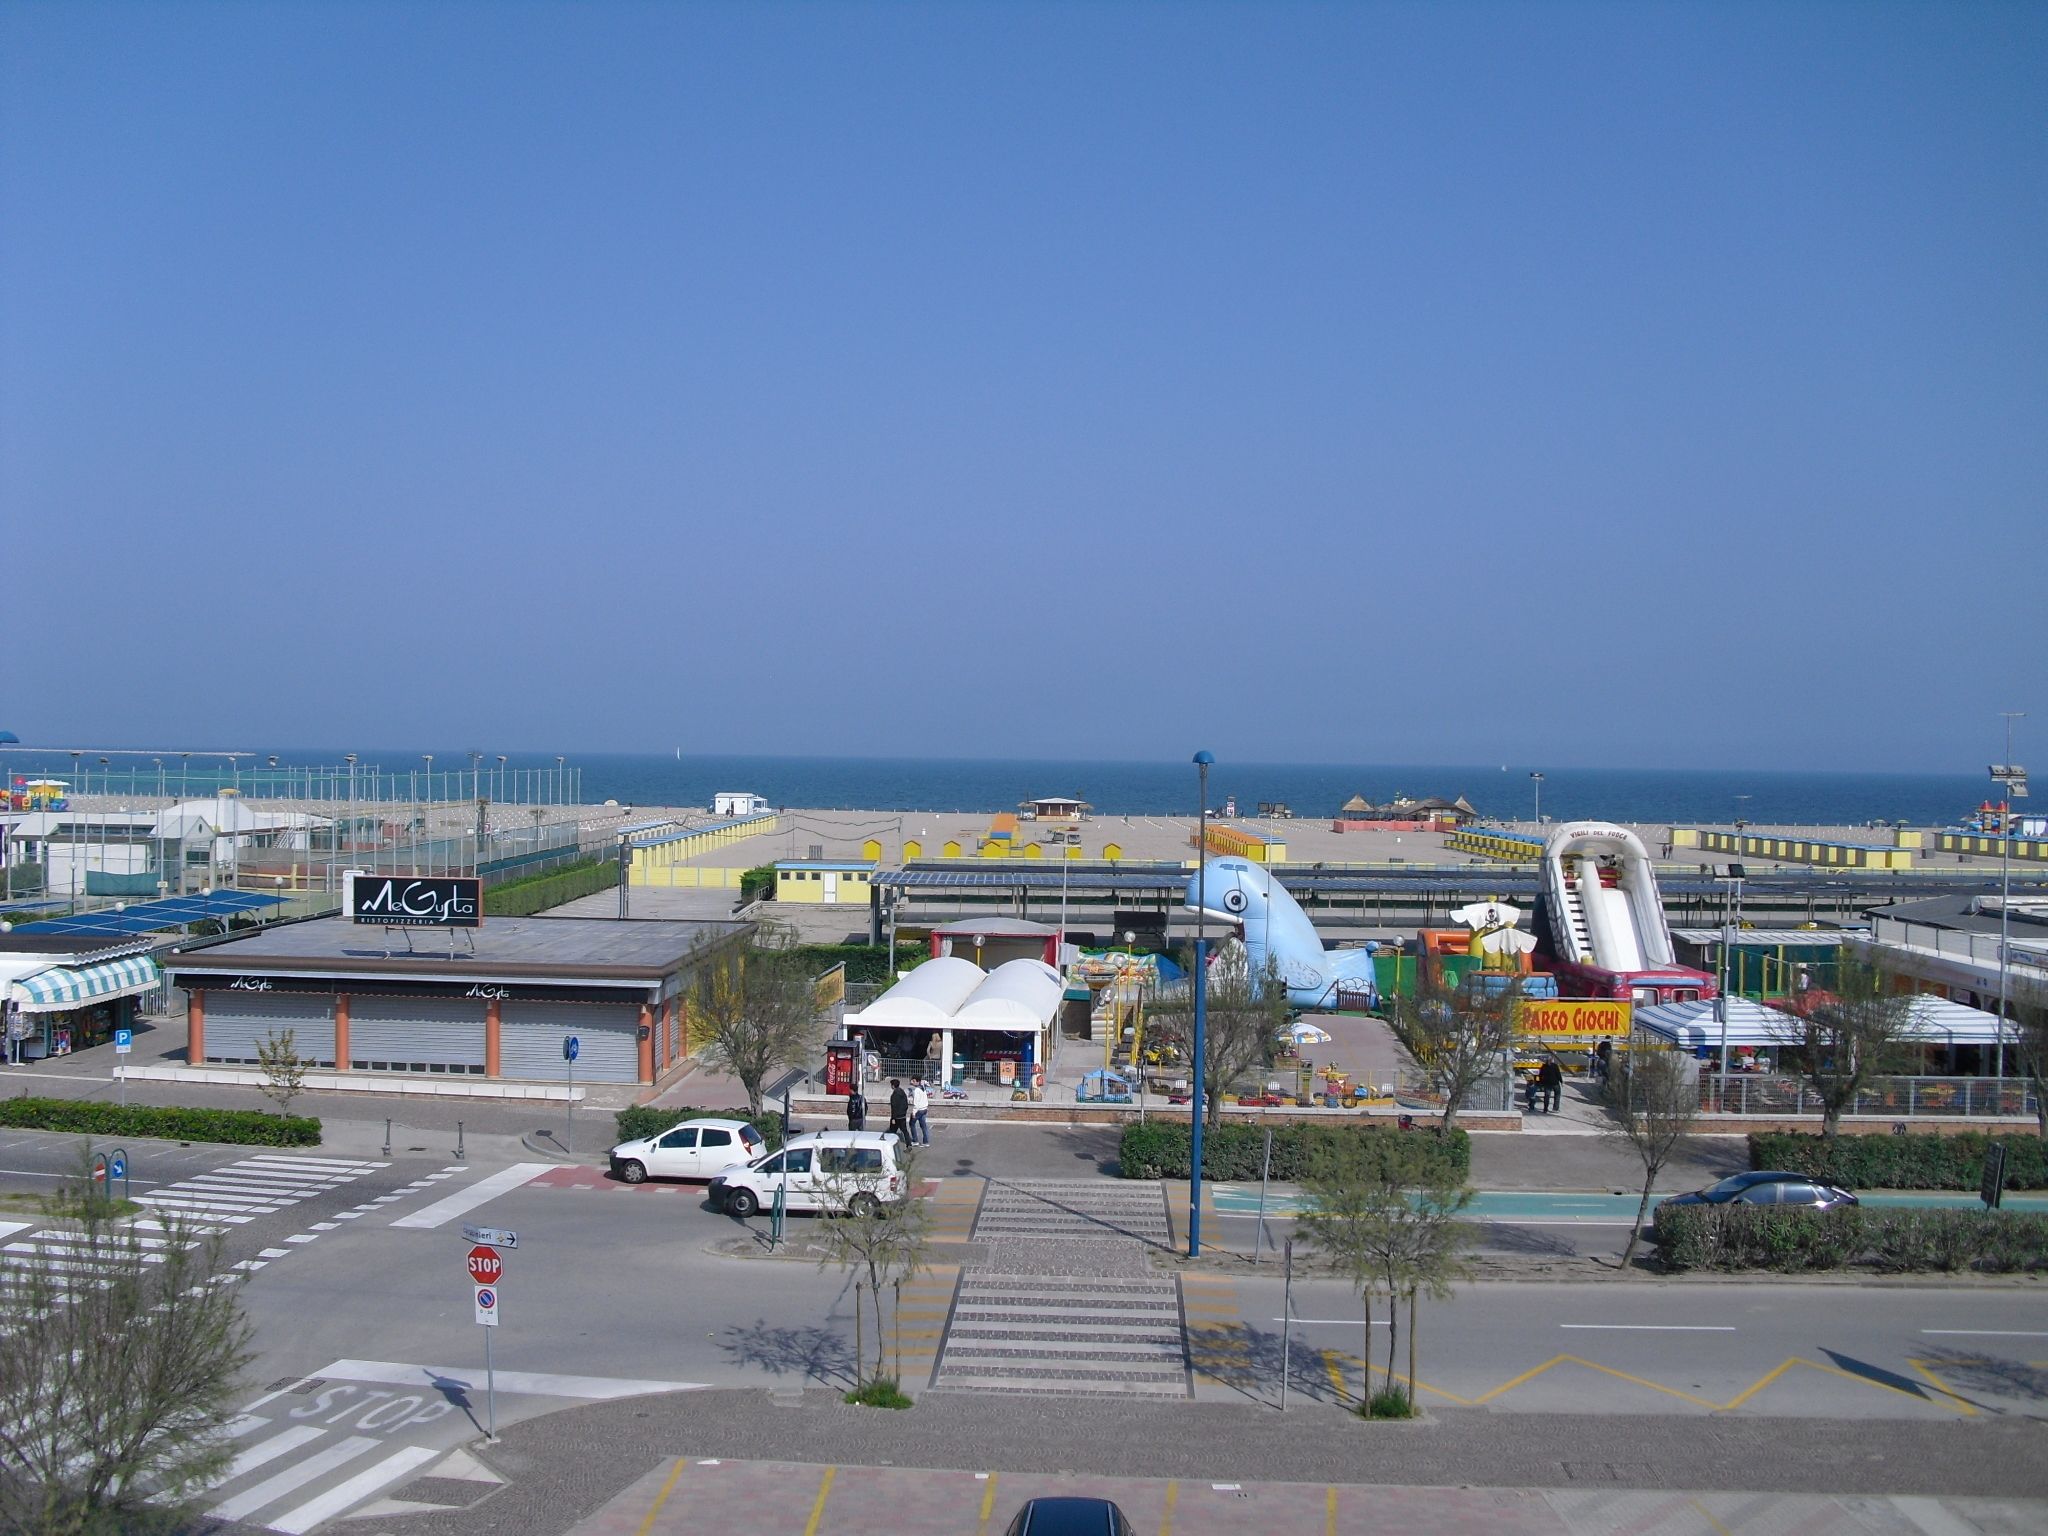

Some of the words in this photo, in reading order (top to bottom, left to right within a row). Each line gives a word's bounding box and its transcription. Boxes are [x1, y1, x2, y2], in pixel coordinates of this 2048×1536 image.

[361, 917, 434, 925] RISTOPIZZERIA
[1523, 1007, 1568, 1031] PARCO
[1573, 1008, 1619, 1031] GIOCHI
[119, 1032, 128, 1043] P
[468, 1257, 500, 1273] STOP
[289, 1385, 455, 1434] STOP
